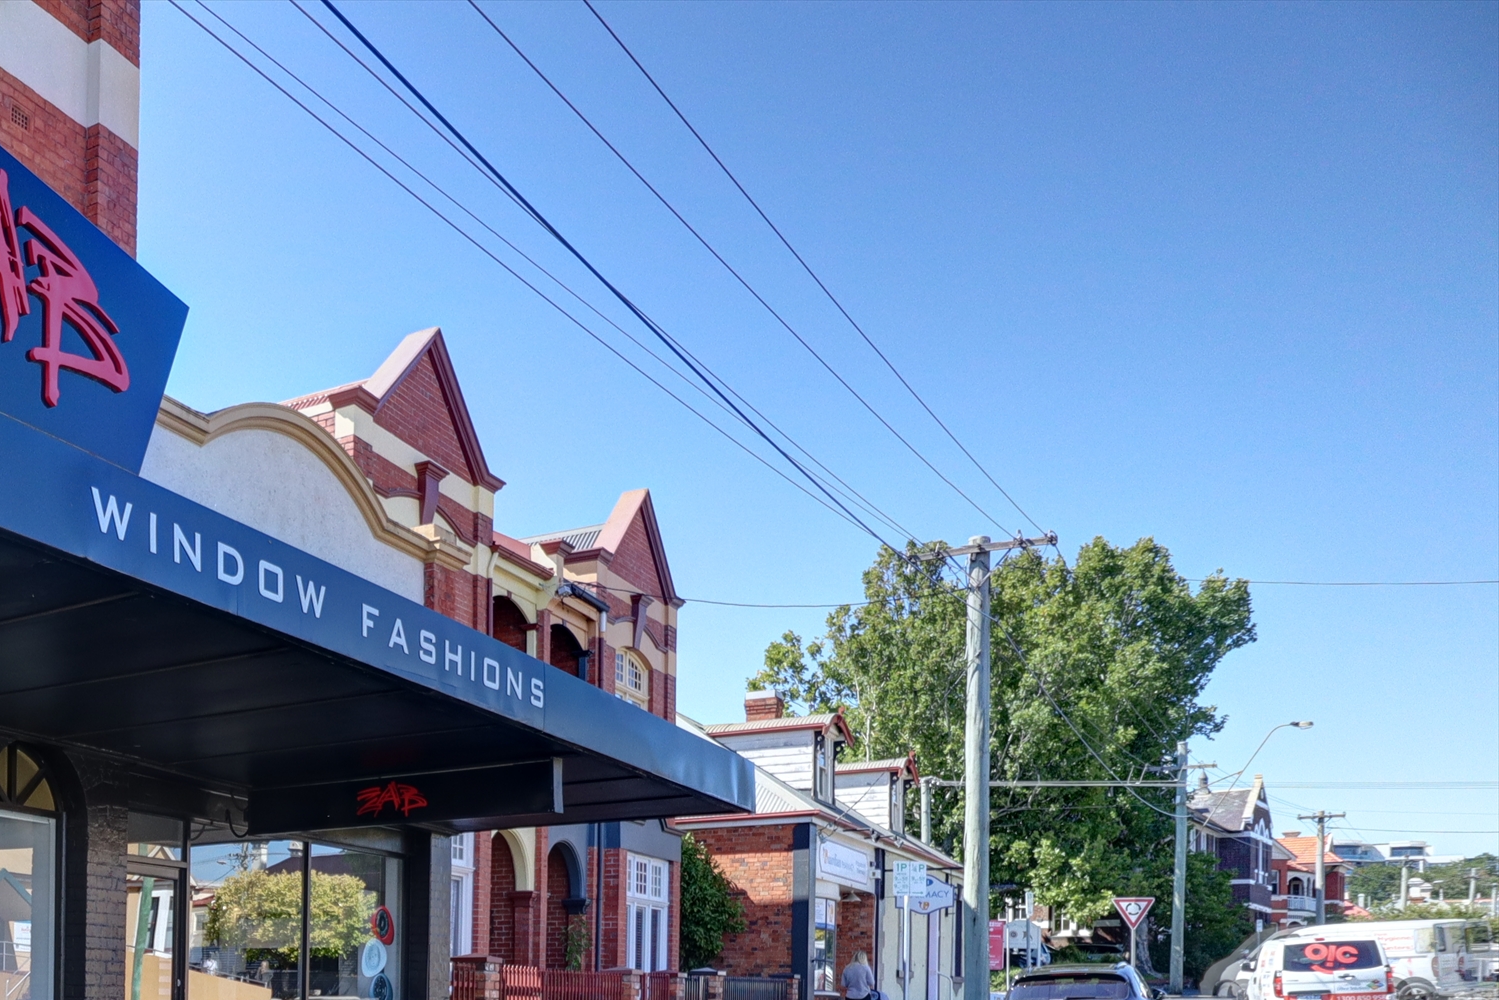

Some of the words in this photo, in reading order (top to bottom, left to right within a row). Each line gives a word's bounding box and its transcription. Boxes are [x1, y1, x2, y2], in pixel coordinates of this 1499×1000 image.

[91, 486, 326, 618] WINDOW
[361, 602, 545, 709] FASHIONS
[896, 863, 908, 872] 1P
